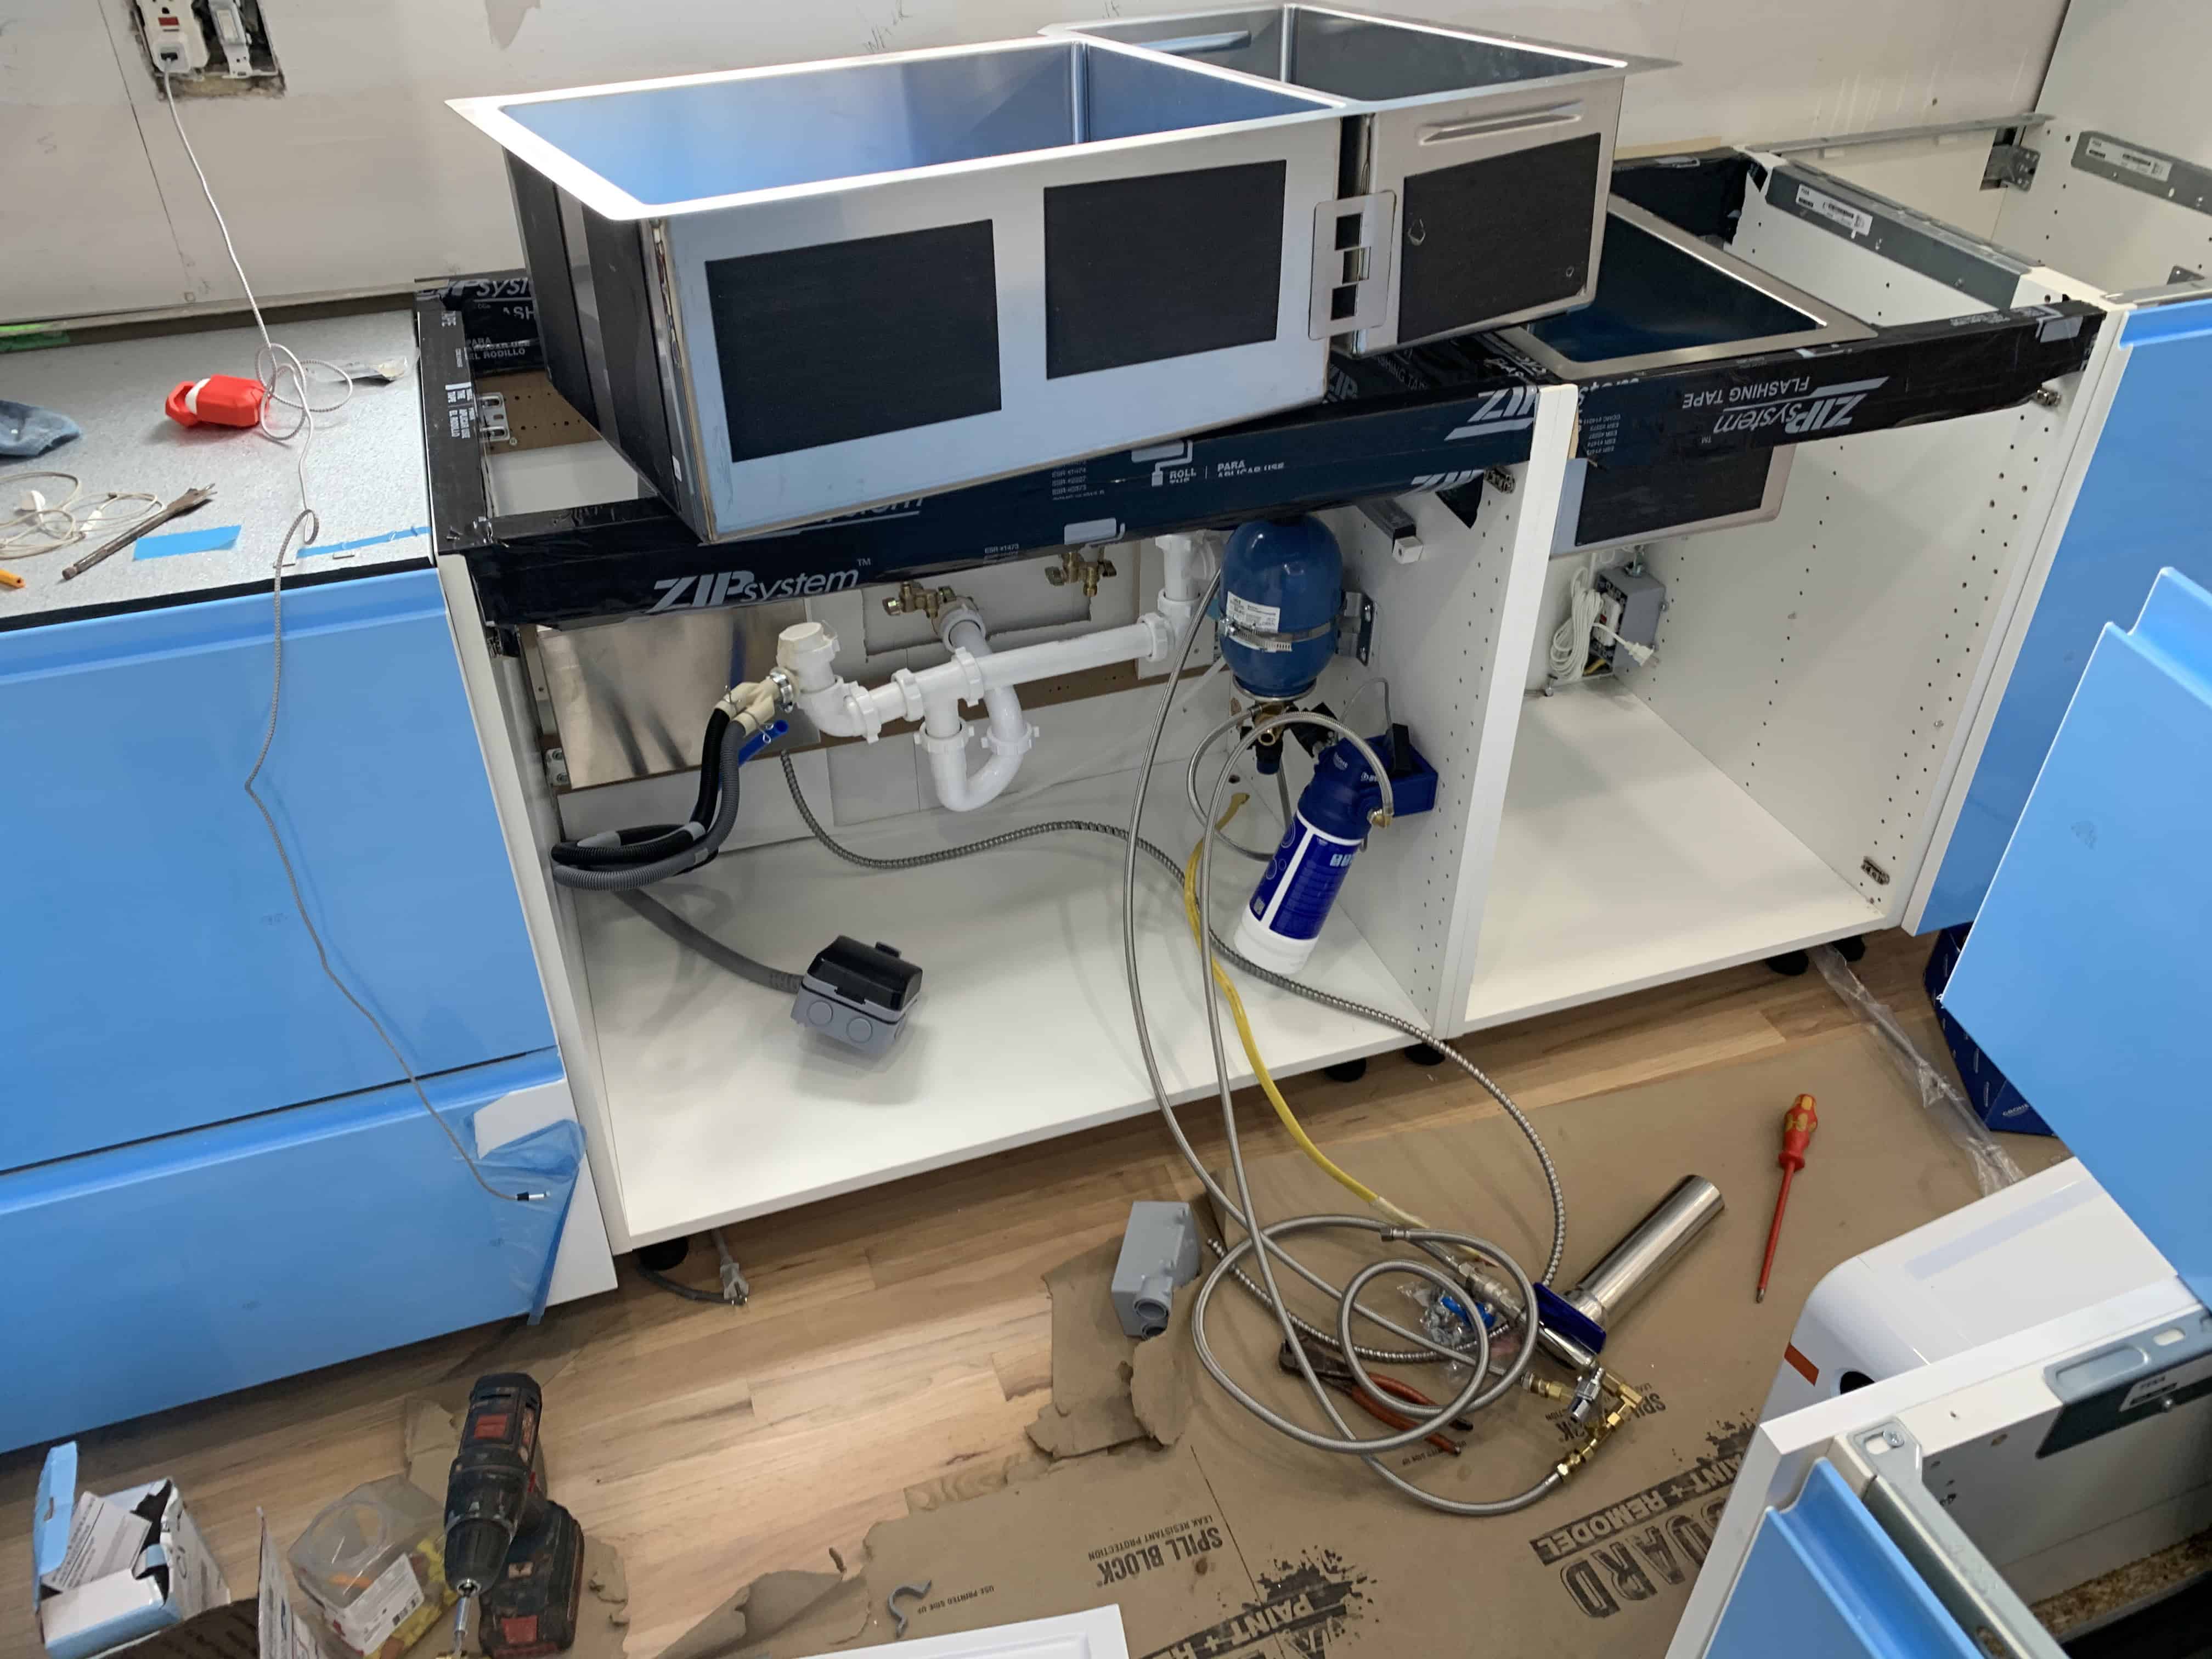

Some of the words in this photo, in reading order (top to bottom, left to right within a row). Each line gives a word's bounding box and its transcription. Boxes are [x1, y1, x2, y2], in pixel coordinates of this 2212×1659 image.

[483, 347, 526, 359] RODILLO
[1682, 390, 1723, 409] TAPE
[1729, 376, 1810, 401] FLASHING
[1169, 467, 1197, 479] ROLL
[1217, 459, 1245, 472] PARA
[1689, 1453, 1742, 1493] AINT
[1144, 1521, 1190, 1543] RESISTANT
[1192, 1515, 1213, 1528] LEAK
[1538, 1490, 1668, 1557] REMODEL
[1088, 1536, 1142, 1561] PROTECTION
[1165, 1527, 1223, 1560] SPILL
[1231, 1593, 1315, 1645] PAINT
